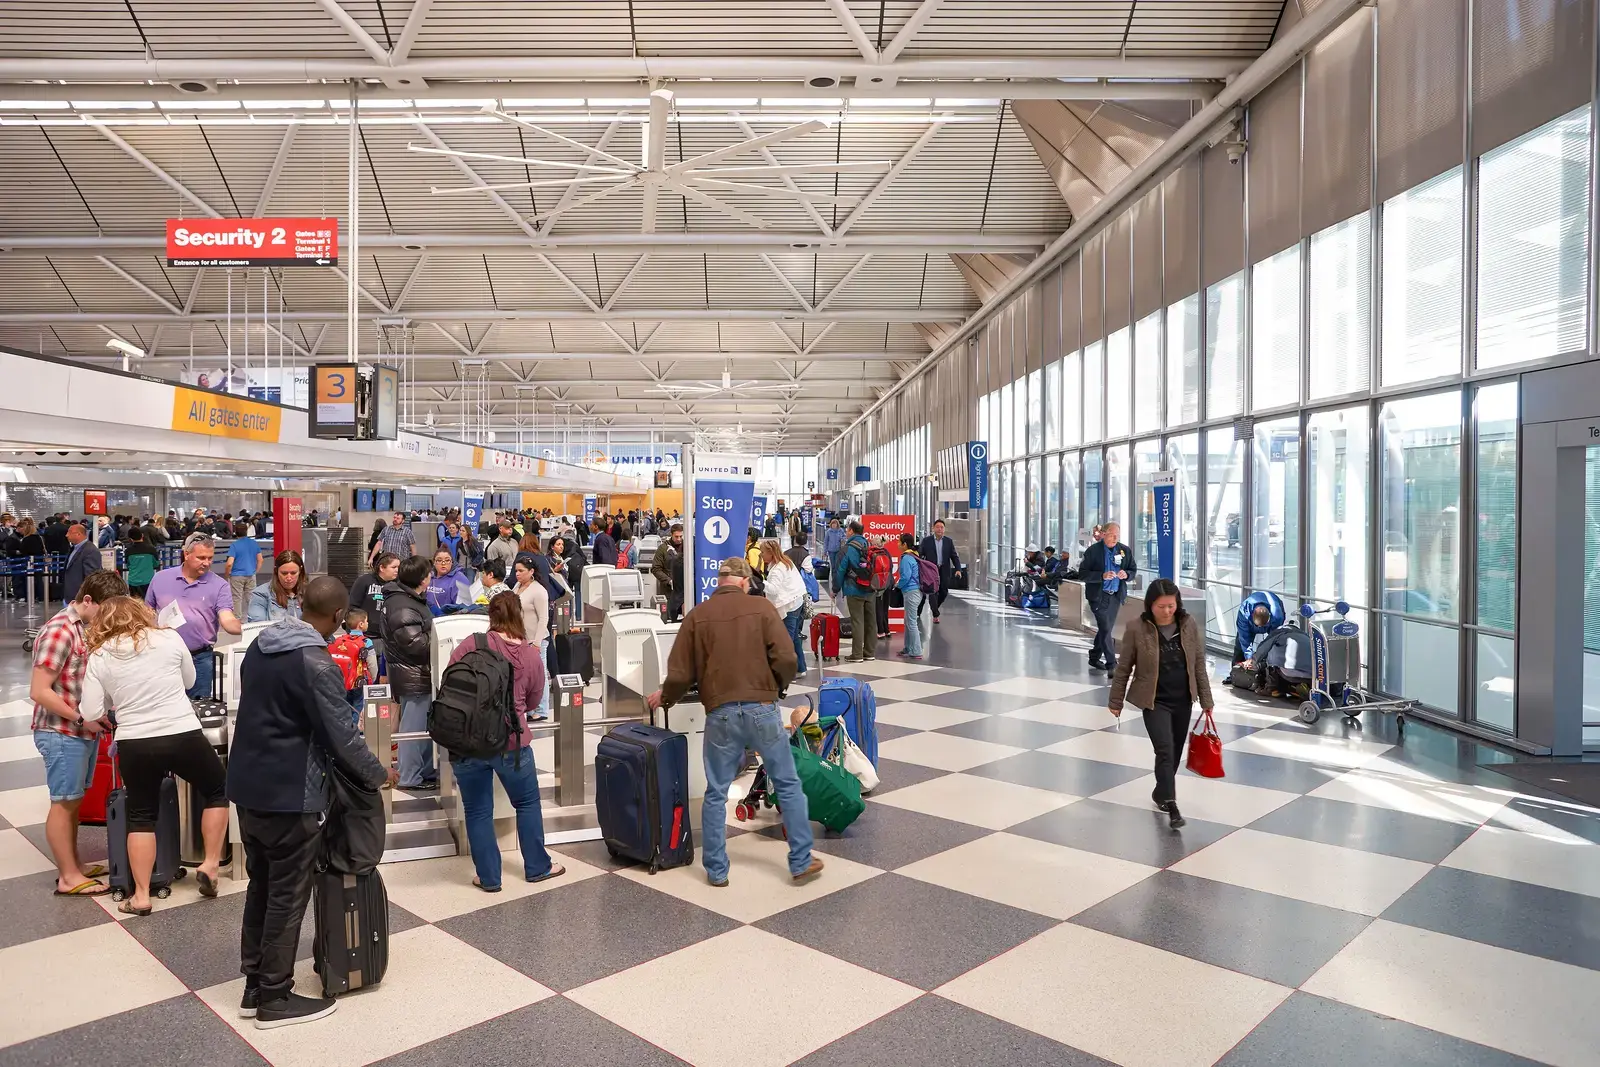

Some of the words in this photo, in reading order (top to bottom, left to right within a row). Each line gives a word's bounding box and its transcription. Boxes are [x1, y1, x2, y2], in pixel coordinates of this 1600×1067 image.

[174, 228, 265, 248] Security
[271, 227, 286, 244] 2
[327, 373, 345, 398] 3
[188, 400, 207, 422] All
[209, 407, 240, 428] gates
[242, 412, 271, 431] enter
[612, 456, 663, 464] UNITED
[702, 495, 733, 512] Step
[1162, 493, 1171, 537] Repack
[712, 520, 722, 539] 1
[869, 521, 906, 531] Security
[862, 532, 912, 541] Checkpo
